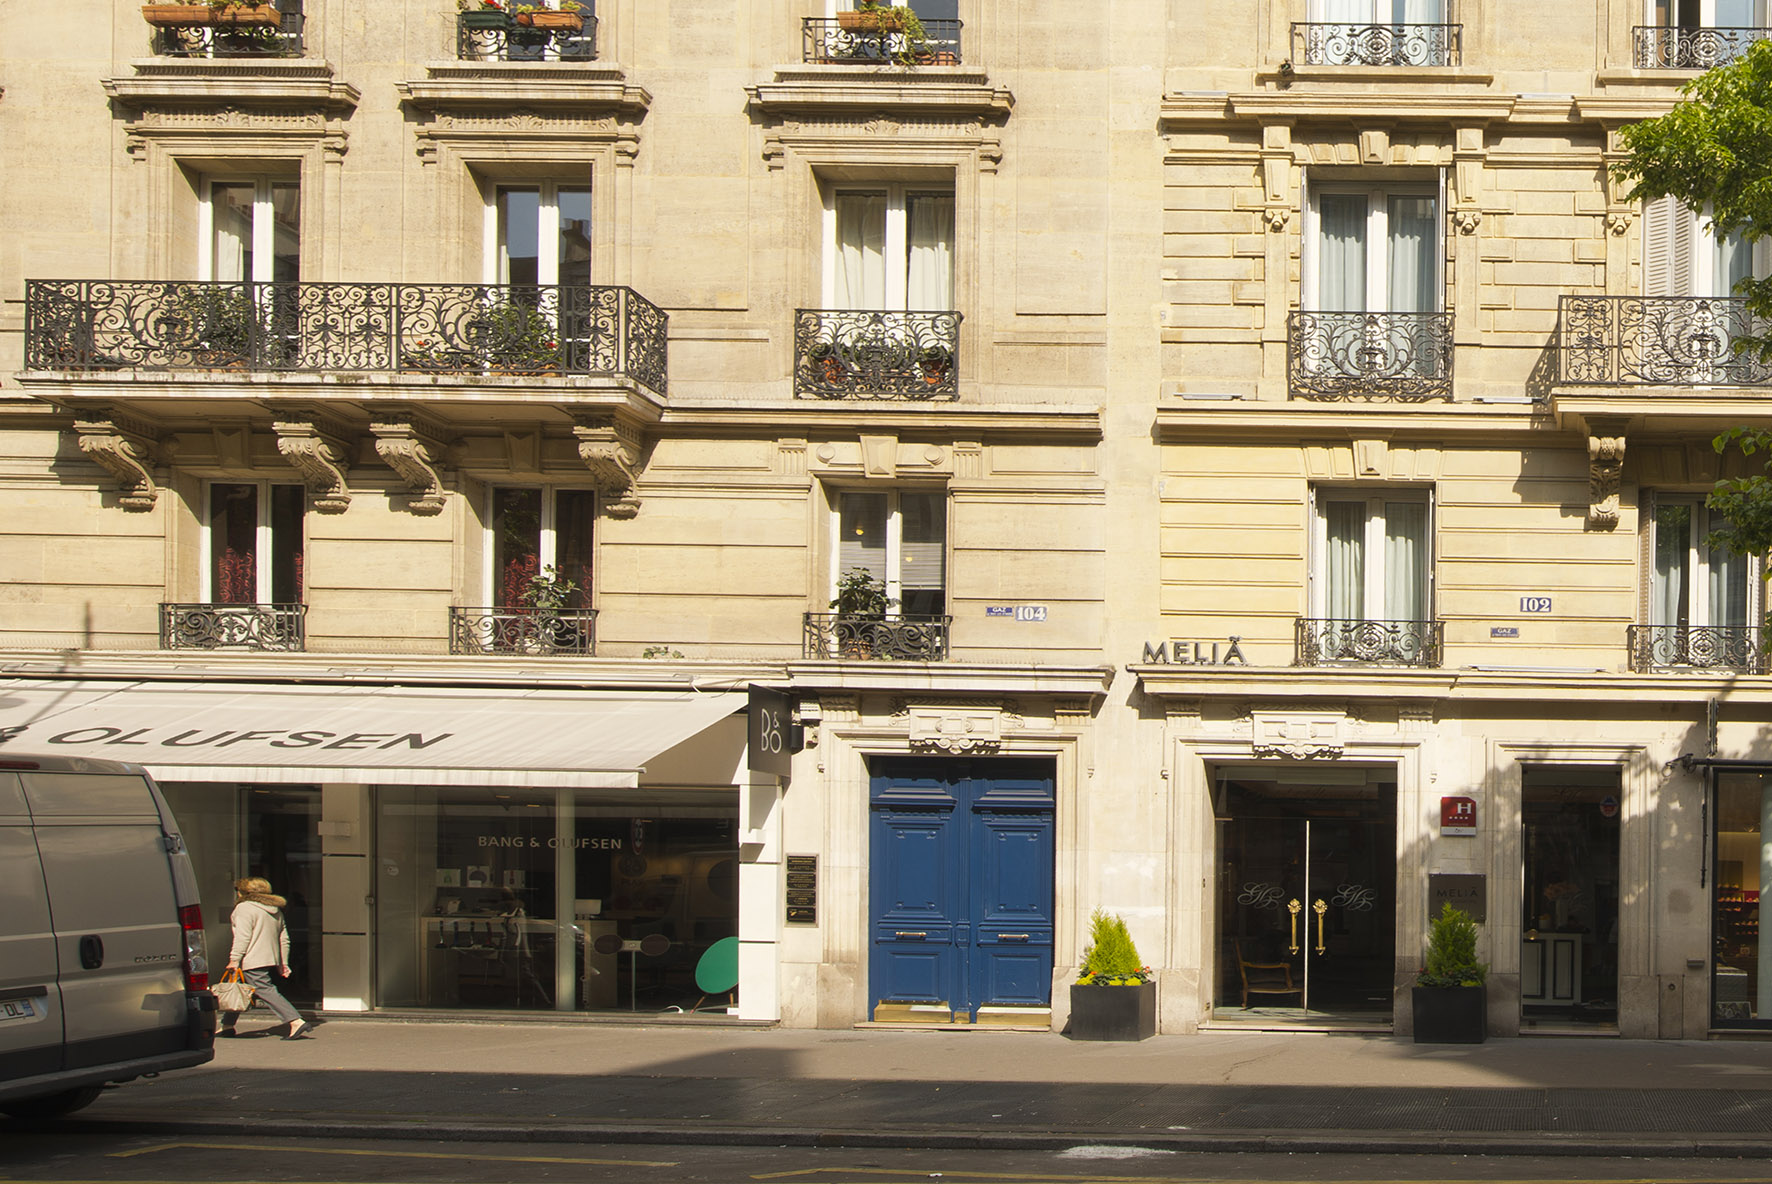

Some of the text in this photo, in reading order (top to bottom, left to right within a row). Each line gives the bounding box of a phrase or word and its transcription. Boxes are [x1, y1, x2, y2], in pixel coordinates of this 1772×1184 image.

[1522, 598, 1550, 612] 102
[1017, 606, 1046, 620] 104
[47, 727, 455, 750] OLUFSEN
[1456, 802, 1472, 814] H
[478, 836, 622, 849] BANG & OLUFSEN
